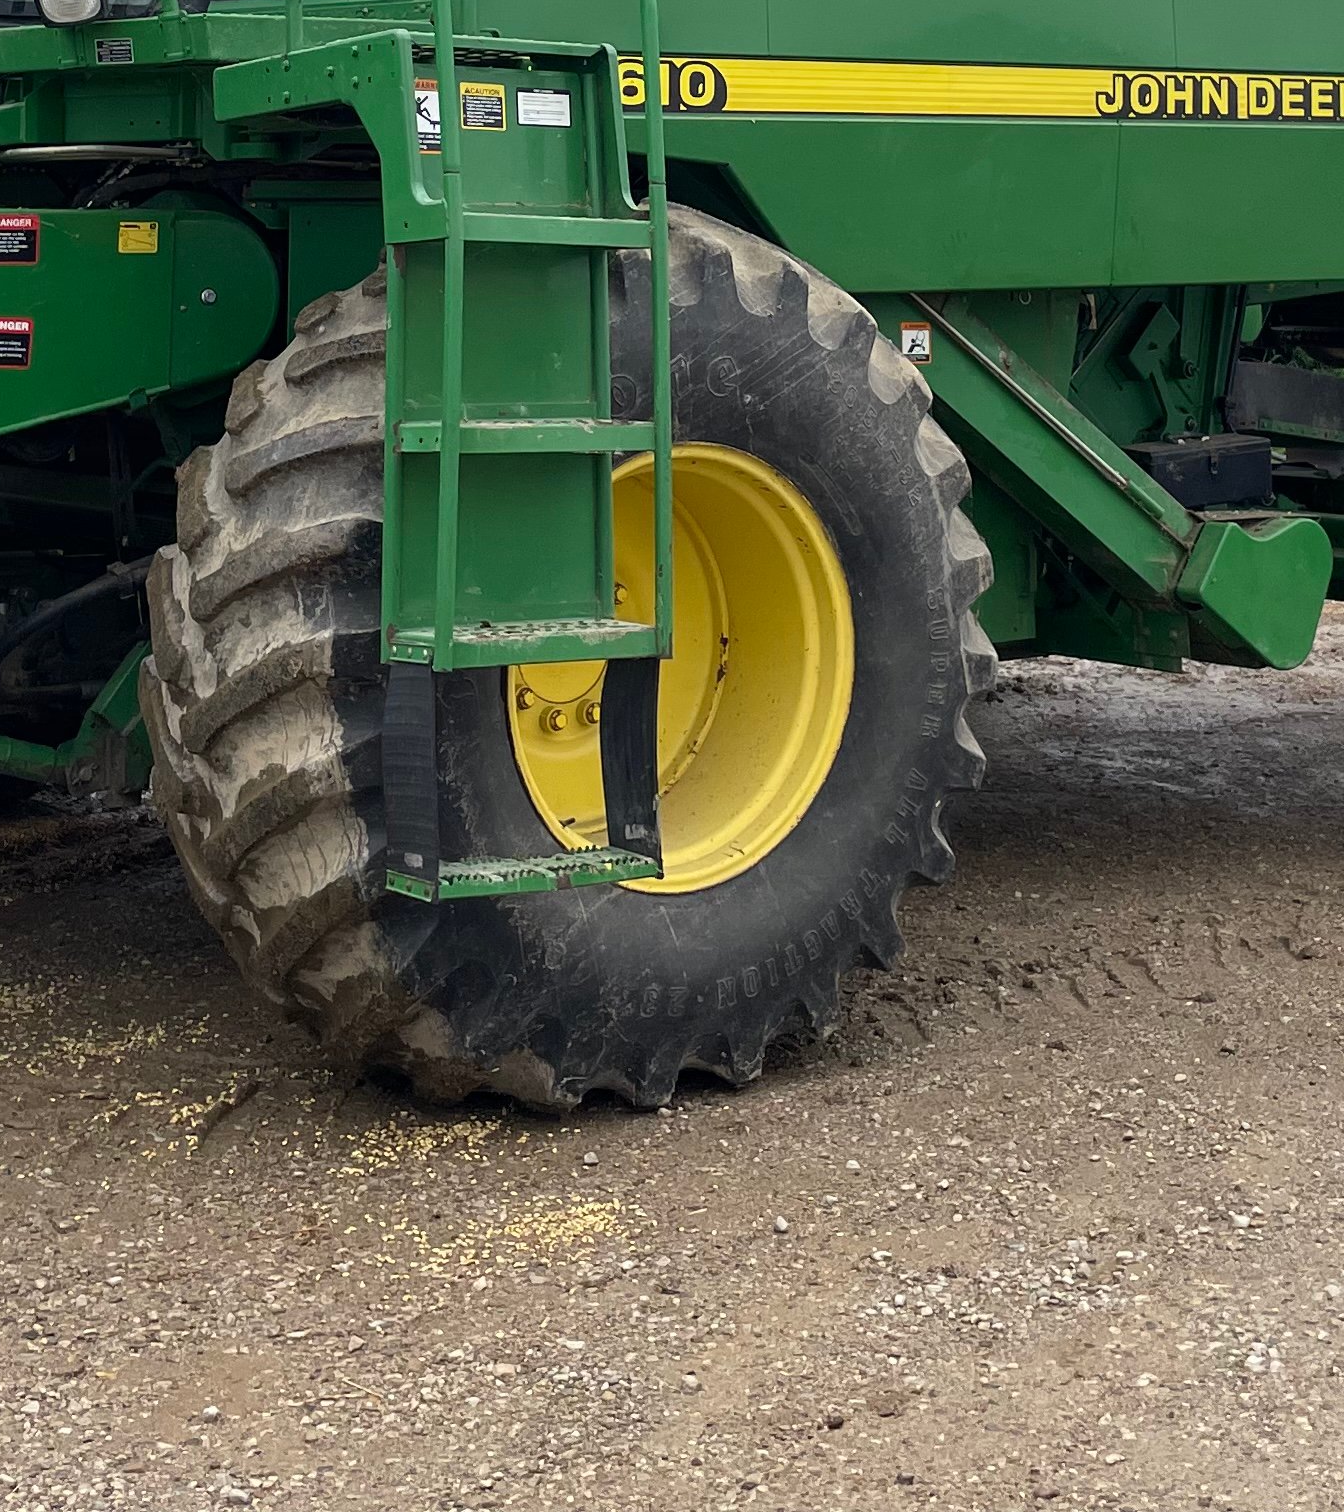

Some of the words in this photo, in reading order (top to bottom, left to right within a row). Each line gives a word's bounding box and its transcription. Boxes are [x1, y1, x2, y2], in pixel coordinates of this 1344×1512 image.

[470, 87, 500, 95] CAUTION
[1096, 75, 1233, 117] JOHN
[919, 586, 950, 739] SUPER
[882, 767, 929, 846] ALL
[715, 866, 888, 1010] TRACTION
